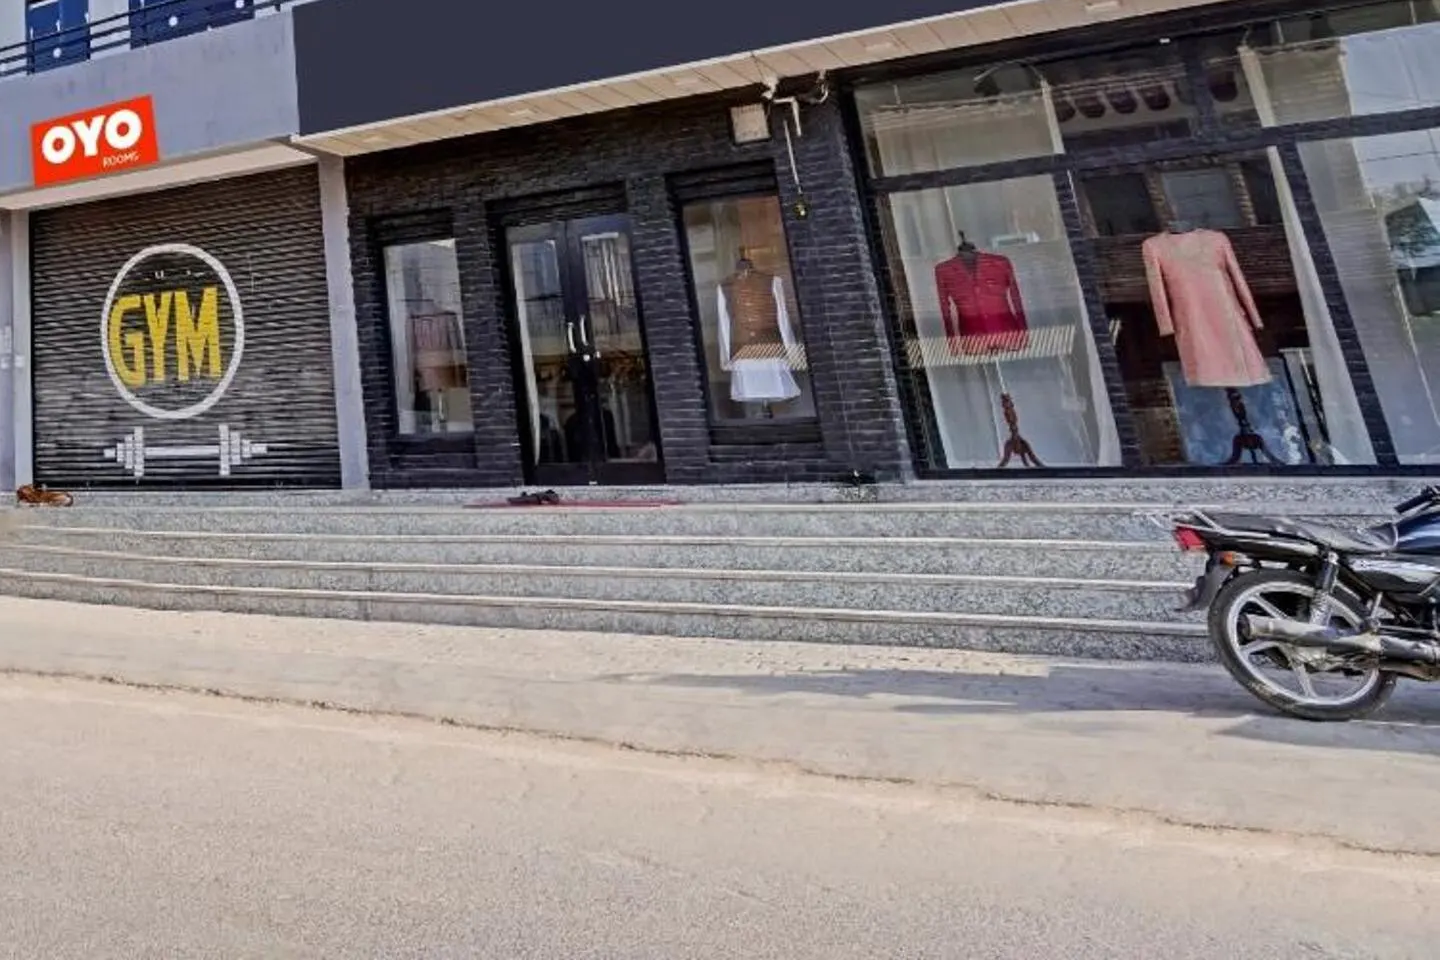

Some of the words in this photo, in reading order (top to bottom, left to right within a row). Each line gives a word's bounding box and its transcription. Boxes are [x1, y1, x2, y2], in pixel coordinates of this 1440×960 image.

[41, 109, 142, 164] OYO
[102, 151, 140, 168] ROOMS
[109, 287, 222, 387] GYM
